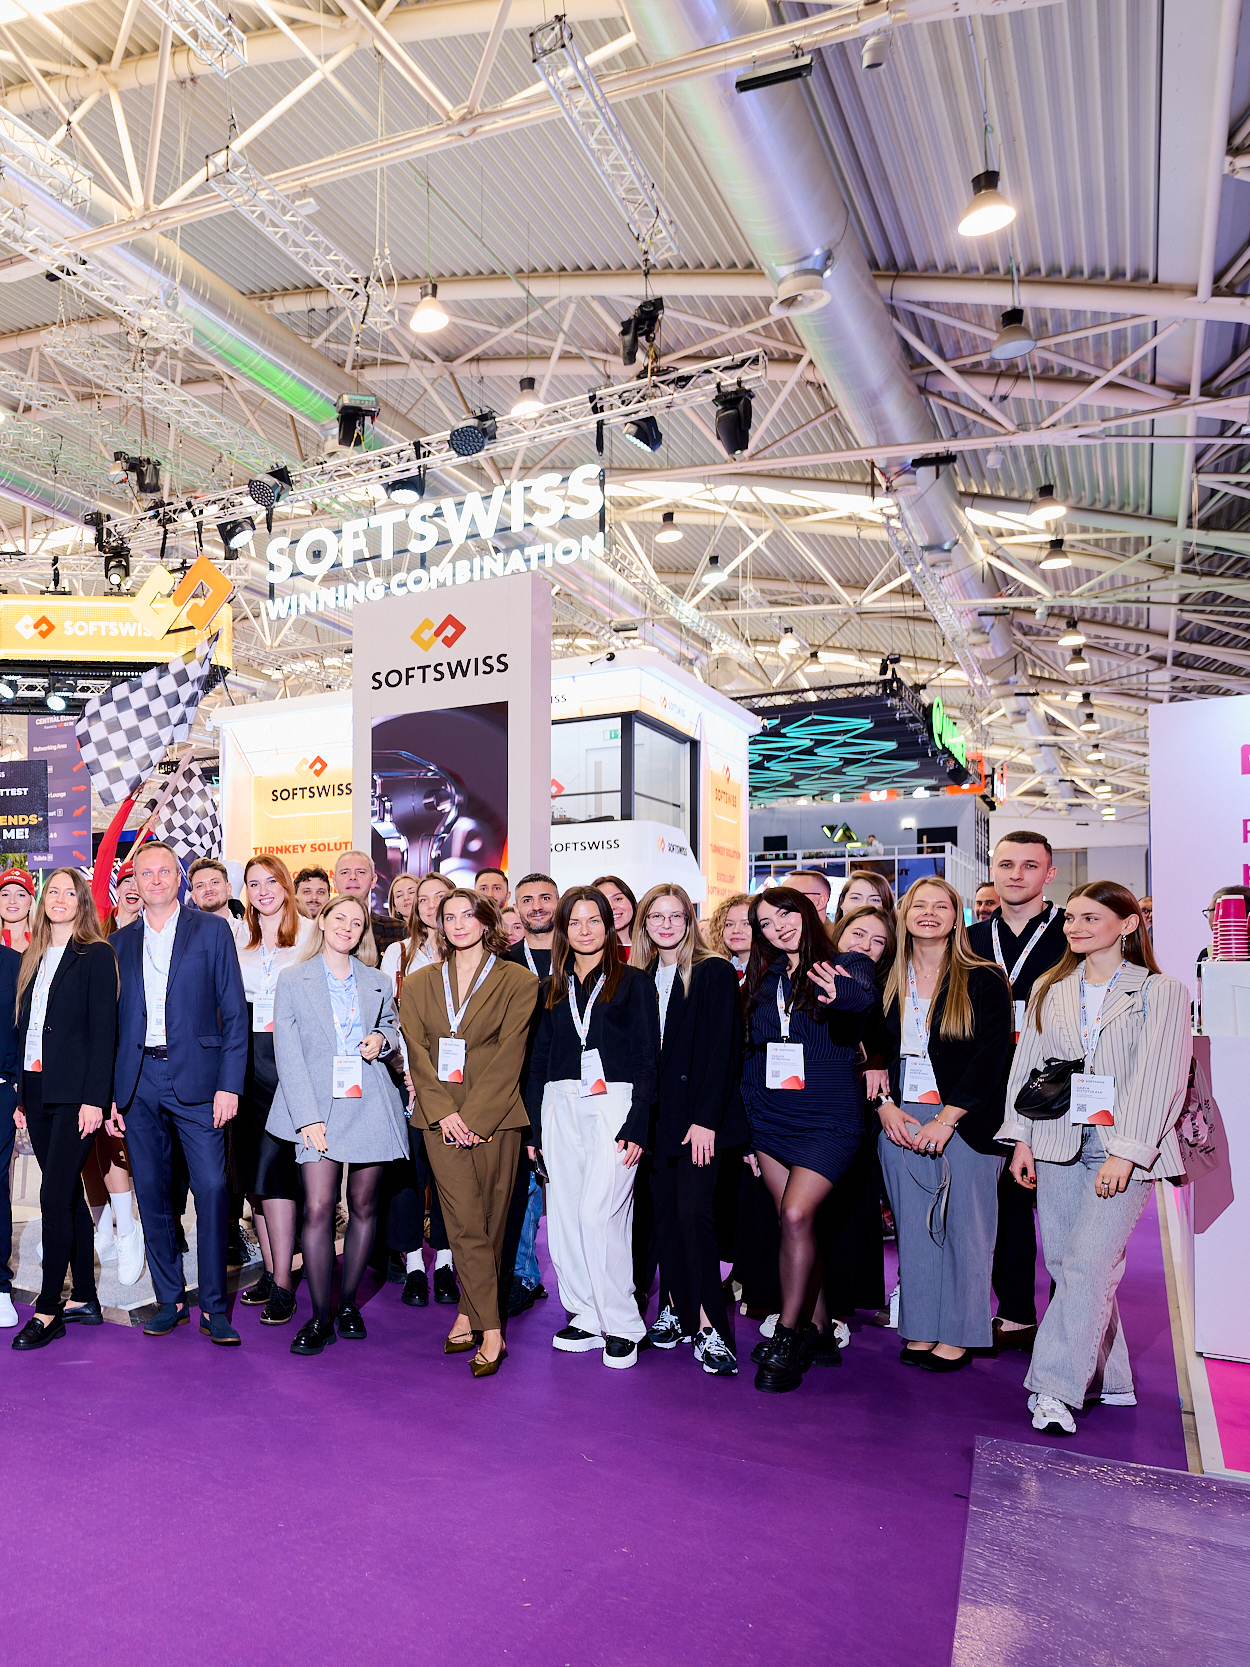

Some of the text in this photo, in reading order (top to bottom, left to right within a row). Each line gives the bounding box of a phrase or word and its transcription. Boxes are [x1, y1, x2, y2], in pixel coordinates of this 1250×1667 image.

[265, 463, 606, 584] SOFTSWISS
[265, 532, 606, 621] WINNING COMBINATION
[63, 620, 152, 638] SOFTSWIS
[371, 653, 510, 690] SOFTSWISS
[33, 744, 57, 752] Networking
[271, 782, 352, 802] SOFTSWISS
[715, 787, 737, 808] SOFTSWISS
[2, 828, 30, 840] ME!
[253, 843, 307, 856] TURNKEY
[668, 842, 688, 856] SOFTSWISS
[716, 872, 735, 883] EXCELLENT
